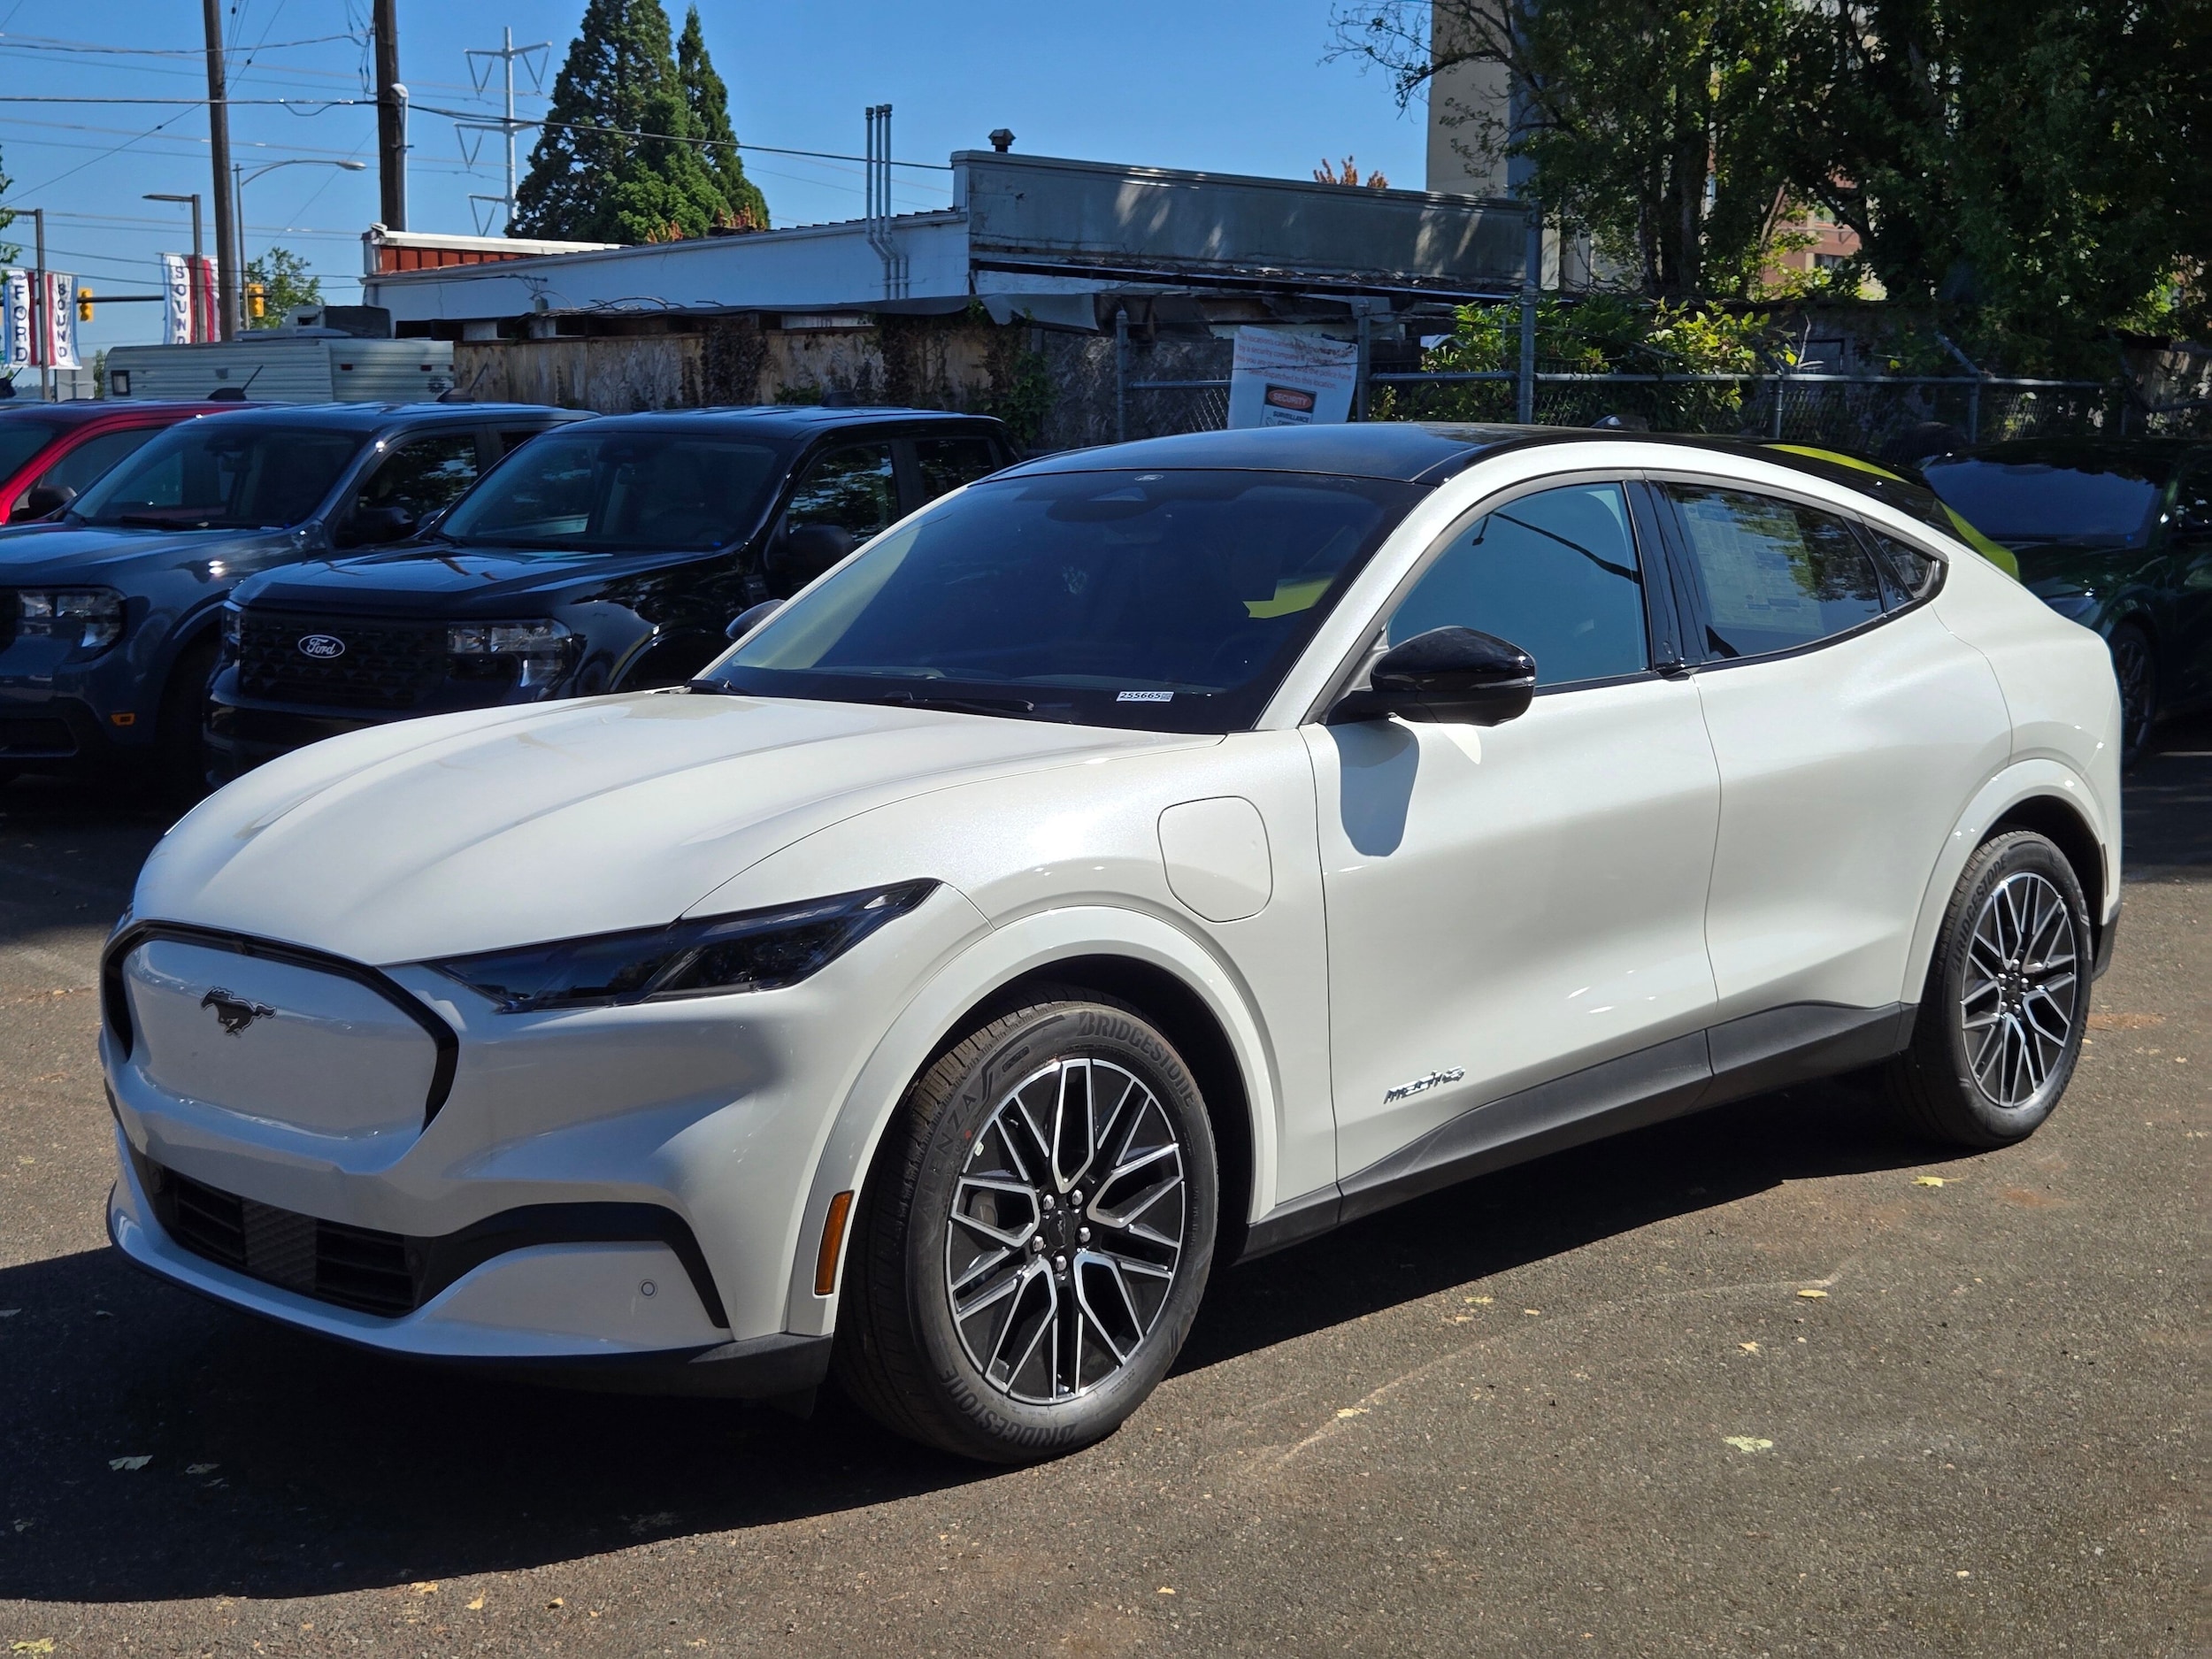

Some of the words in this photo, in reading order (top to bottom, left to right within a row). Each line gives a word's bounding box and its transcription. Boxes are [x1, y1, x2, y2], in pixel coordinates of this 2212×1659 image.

[13, 285, 27, 362] FORD
[58, 284, 67, 357] SOUND
[175, 266, 187, 344] SOUND
[1273, 393, 1309, 405] SECURITY
[1273, 411, 1310, 423] SURVEILLANCE
[306, 637, 336, 655] Ford
[1076, 1010, 1200, 1108] BRIDGESTONE
[938, 1364, 1078, 1448] BRIDGESTONE
